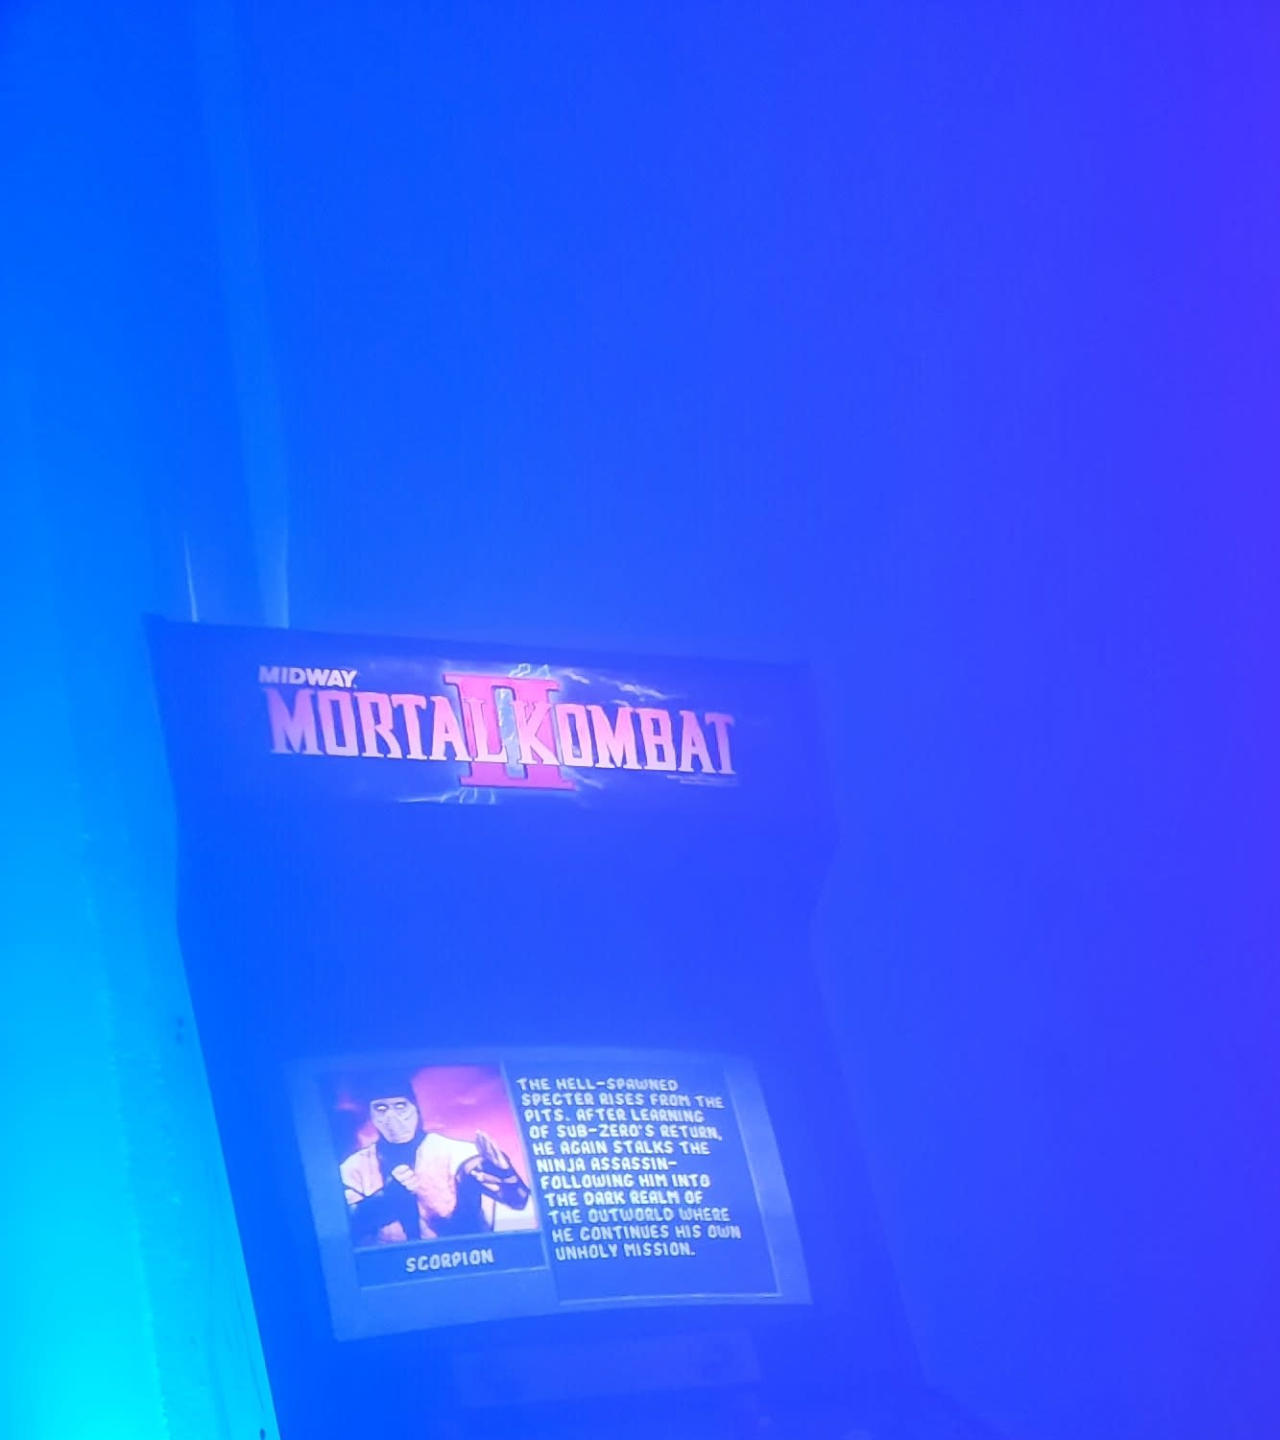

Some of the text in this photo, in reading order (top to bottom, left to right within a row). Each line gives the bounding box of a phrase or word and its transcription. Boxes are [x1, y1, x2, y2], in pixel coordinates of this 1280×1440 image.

[259, 666, 357, 688] MIDWAY
[263, 688, 737, 775] MORTAL KOMBAT
[443, 673, 576, 791] II
[517, 1078, 678, 1092] THE HELL-SPAWNED
[521, 1093, 725, 1109] SPECTER RISES FROM THE
[524, 1108, 705, 1123] PITS. AFTER LEARNING
[529, 1124, 723, 1141] OF SUB-ZERO'S RETURN,
[532, 1141, 711, 1156] HE AGAIN STALKS THE
[536, 1157, 678, 1173] NINJA ASSASSIN-
[540, 1174, 711, 1190] FOLLOWING HIM INTO
[545, 1190, 703, 1207] THE DARK REALM OF
[548, 1208, 731, 1225] THE OUTWORLD WHERE
[552, 1225, 742, 1243] HE CONTINUES HIS OWN
[555, 1242, 696, 1261] UNHOLY MISSION.
[405, 1248, 495, 1273] SCORPION
